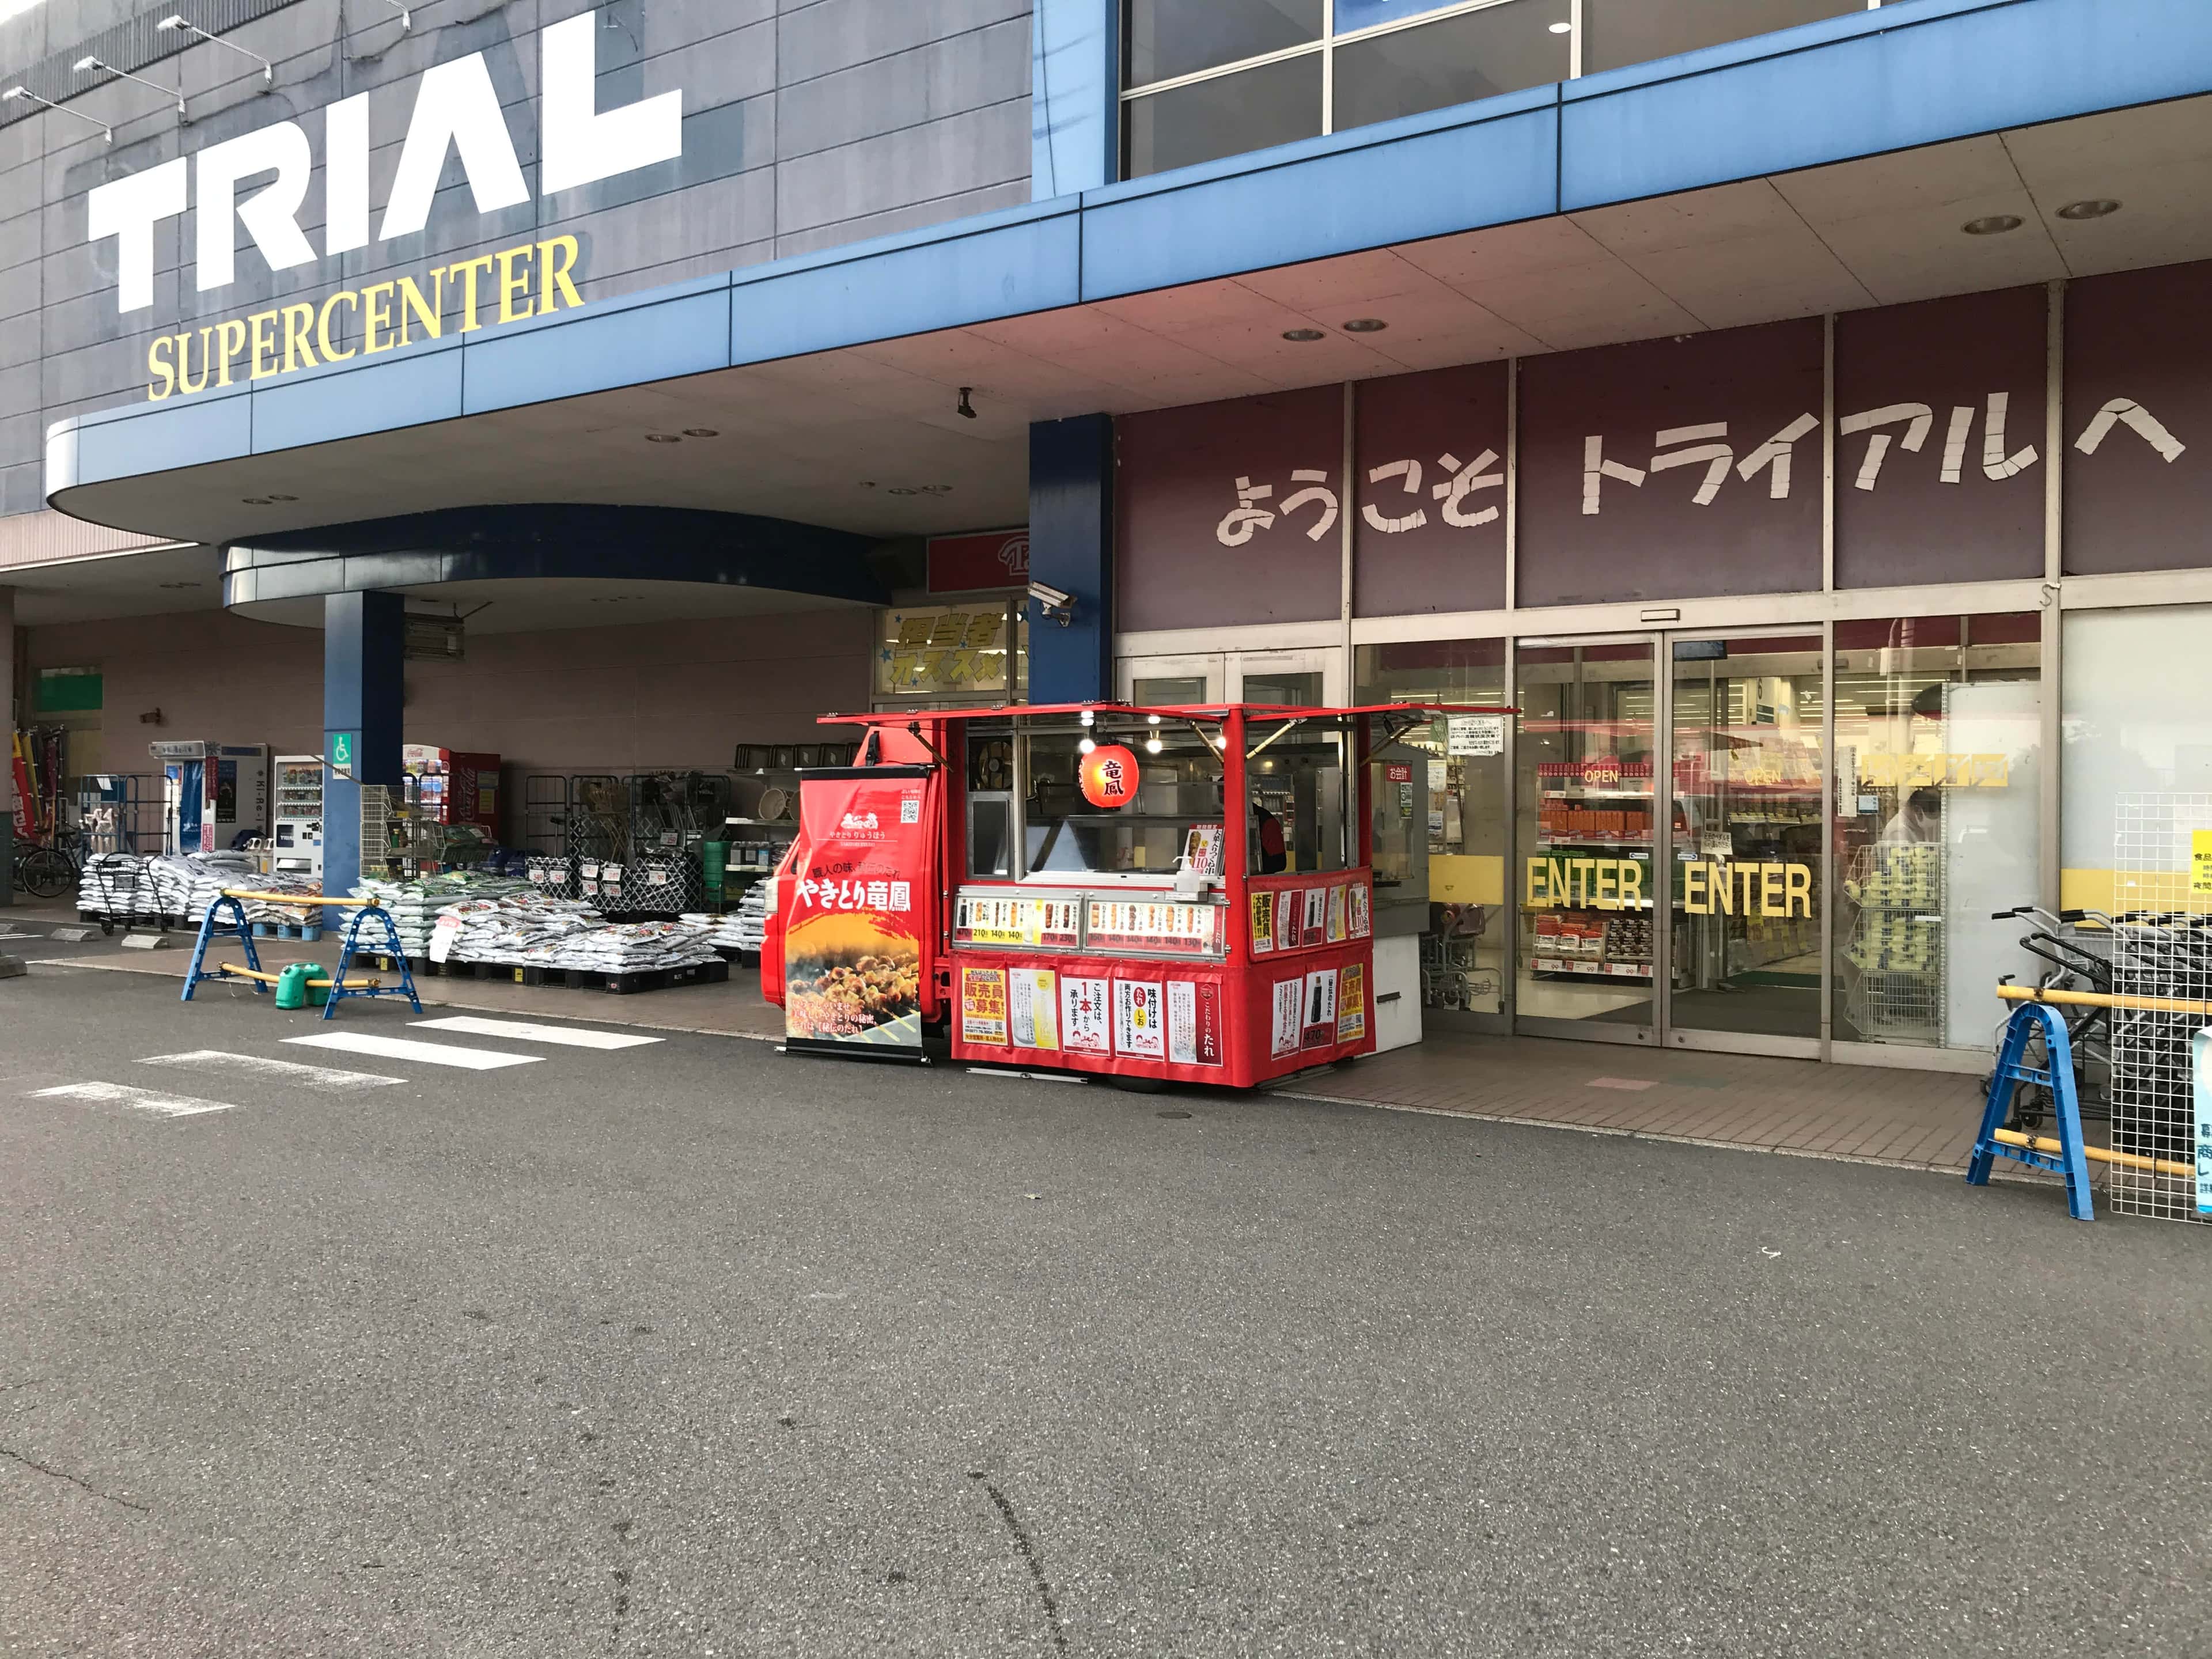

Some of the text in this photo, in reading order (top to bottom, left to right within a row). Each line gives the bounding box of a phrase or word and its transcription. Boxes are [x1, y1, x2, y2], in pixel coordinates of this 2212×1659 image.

[88, 10, 682, 313] TRIAL
[147, 235, 585, 402] SUPERCENTER
[1217, 392, 2186, 548] ようこそ トライアルへ
[895, 612, 1006, 650] 担当者
[1102, 760, 1124, 796] 竜鳳
[1585, 770, 1618, 783] OPEN
[798, 878, 911, 912] やきとり竜鳳
[1527, 857, 1642, 911] ENTER
[1684, 861, 1811, 918] ENTER
[991, 930, 1002, 938] 140
[1008, 931, 1020, 939] 140
[964, 982, 1003, 999] 販売員
[1080, 982, 1092, 1032] 1本から
[1094, 983, 1102, 1024] ご注文は、
[1136, 989, 1144, 1005] たれ
[1147, 988, 1157, 1029] 味付けは
[1137, 1010, 1144, 1027] しお
[1204, 1002, 1215, 1057] こだわりのたれ
